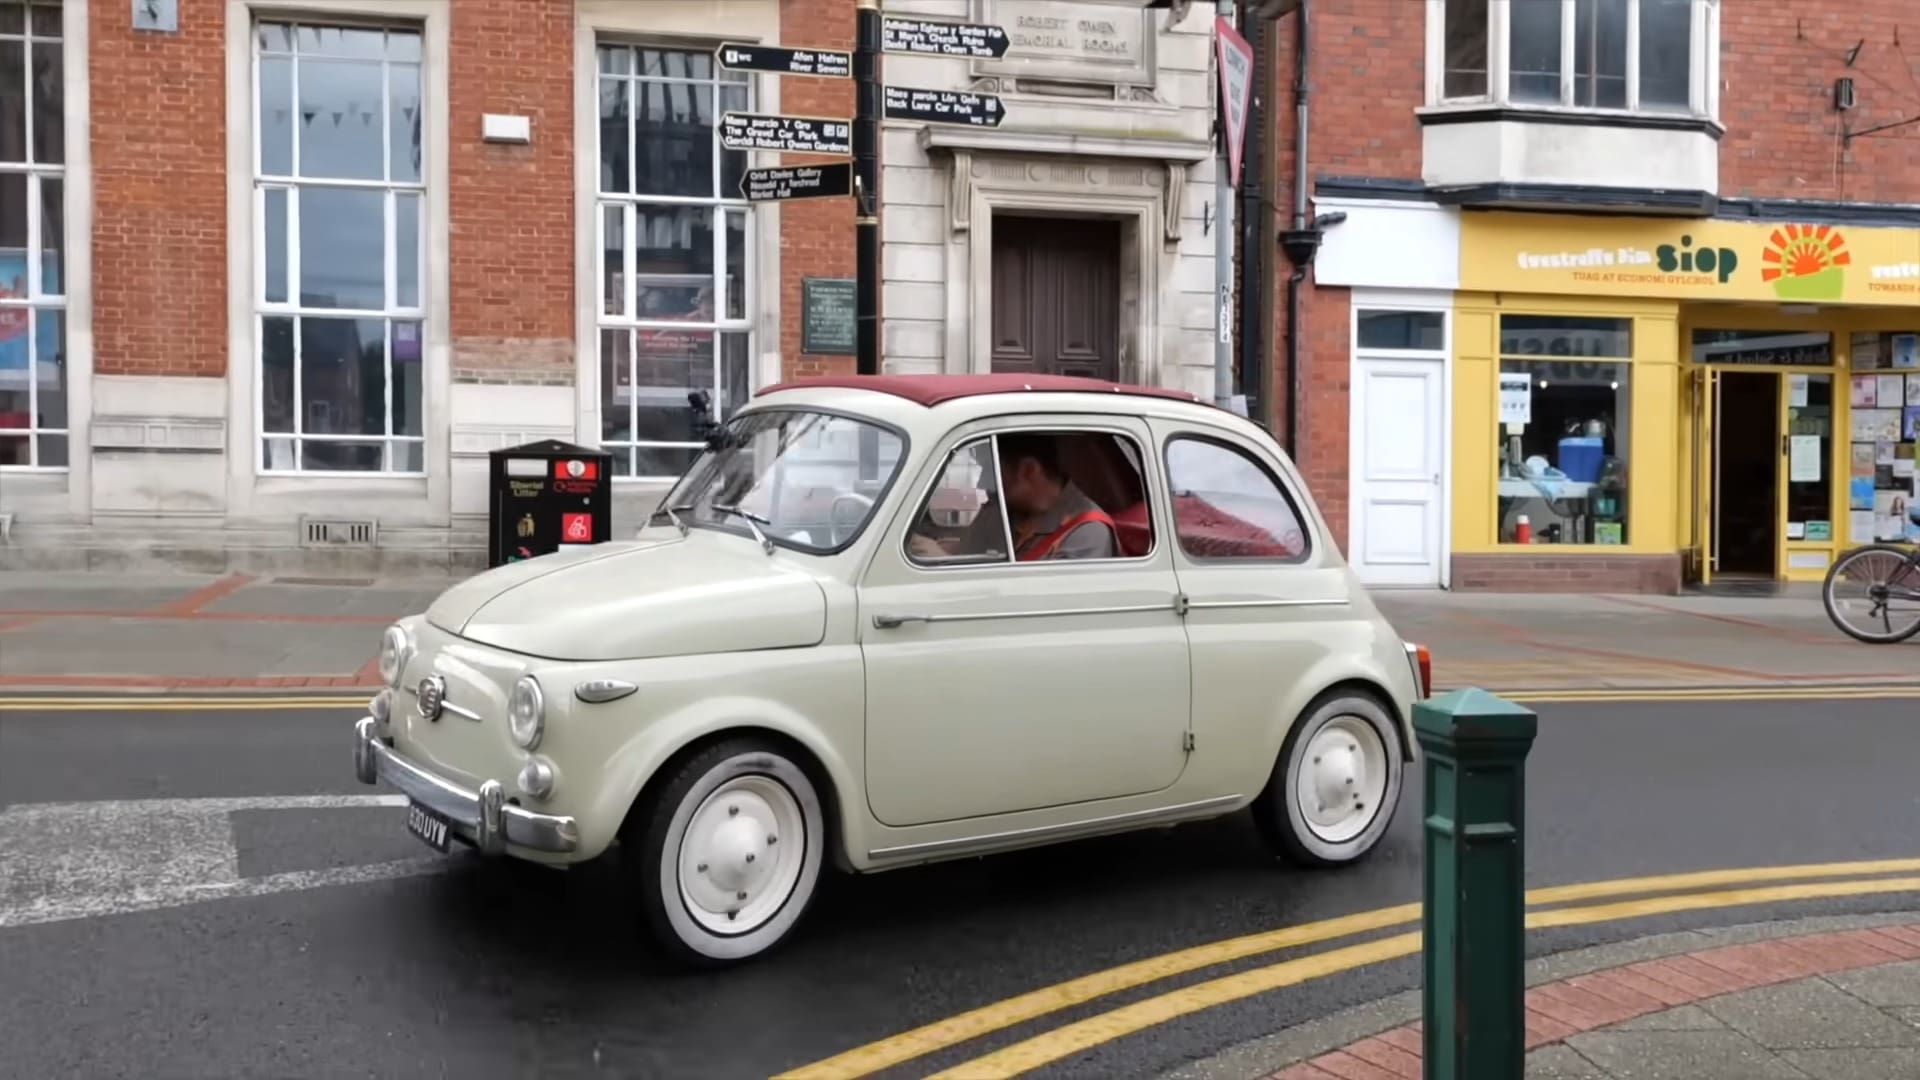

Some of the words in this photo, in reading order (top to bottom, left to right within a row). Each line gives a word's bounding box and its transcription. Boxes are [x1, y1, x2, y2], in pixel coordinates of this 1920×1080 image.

[1078, 20, 1117, 34] OWEN
[929, 33, 959, 44] Church
[1012, 33, 1073, 49] EMORIAL
[943, 44, 967, 54] Owen
[971, 46, 993, 56] Tomb
[793, 51, 814, 62] Afon
[818, 53, 848, 65] Hafren
[790, 61, 813, 72] River
[817, 63, 848, 74] Severn
[886, 88, 908, 99] Maes
[912, 92, 938, 103] parcio
[886, 98, 907, 109] Back
[911, 100, 931, 111] Lane
[935, 102, 950, 113] Car
[954, 104, 972, 114] Park
[752, 119, 779, 129] parcio
[783, 120, 790, 129] Y
[726, 126, 742, 136] The
[778, 129, 794, 139] Car
[798, 131, 819, 141] Park
[756, 138, 785, 149] Robert
[787, 140, 812, 150] Owen
[814, 141, 849, 152] Gardens
[797, 168, 822, 179] Gallery
[1573, 271, 1600, 282] TUAG
[1602, 273, 1616, 282] AT
[1617, 272, 1665, 284] ECONOMI
[1667, 275, 1715, 286] GYLCHOL
[1868, 283, 1914, 293] TOWARDS
[513, 488, 538, 497] Litter
